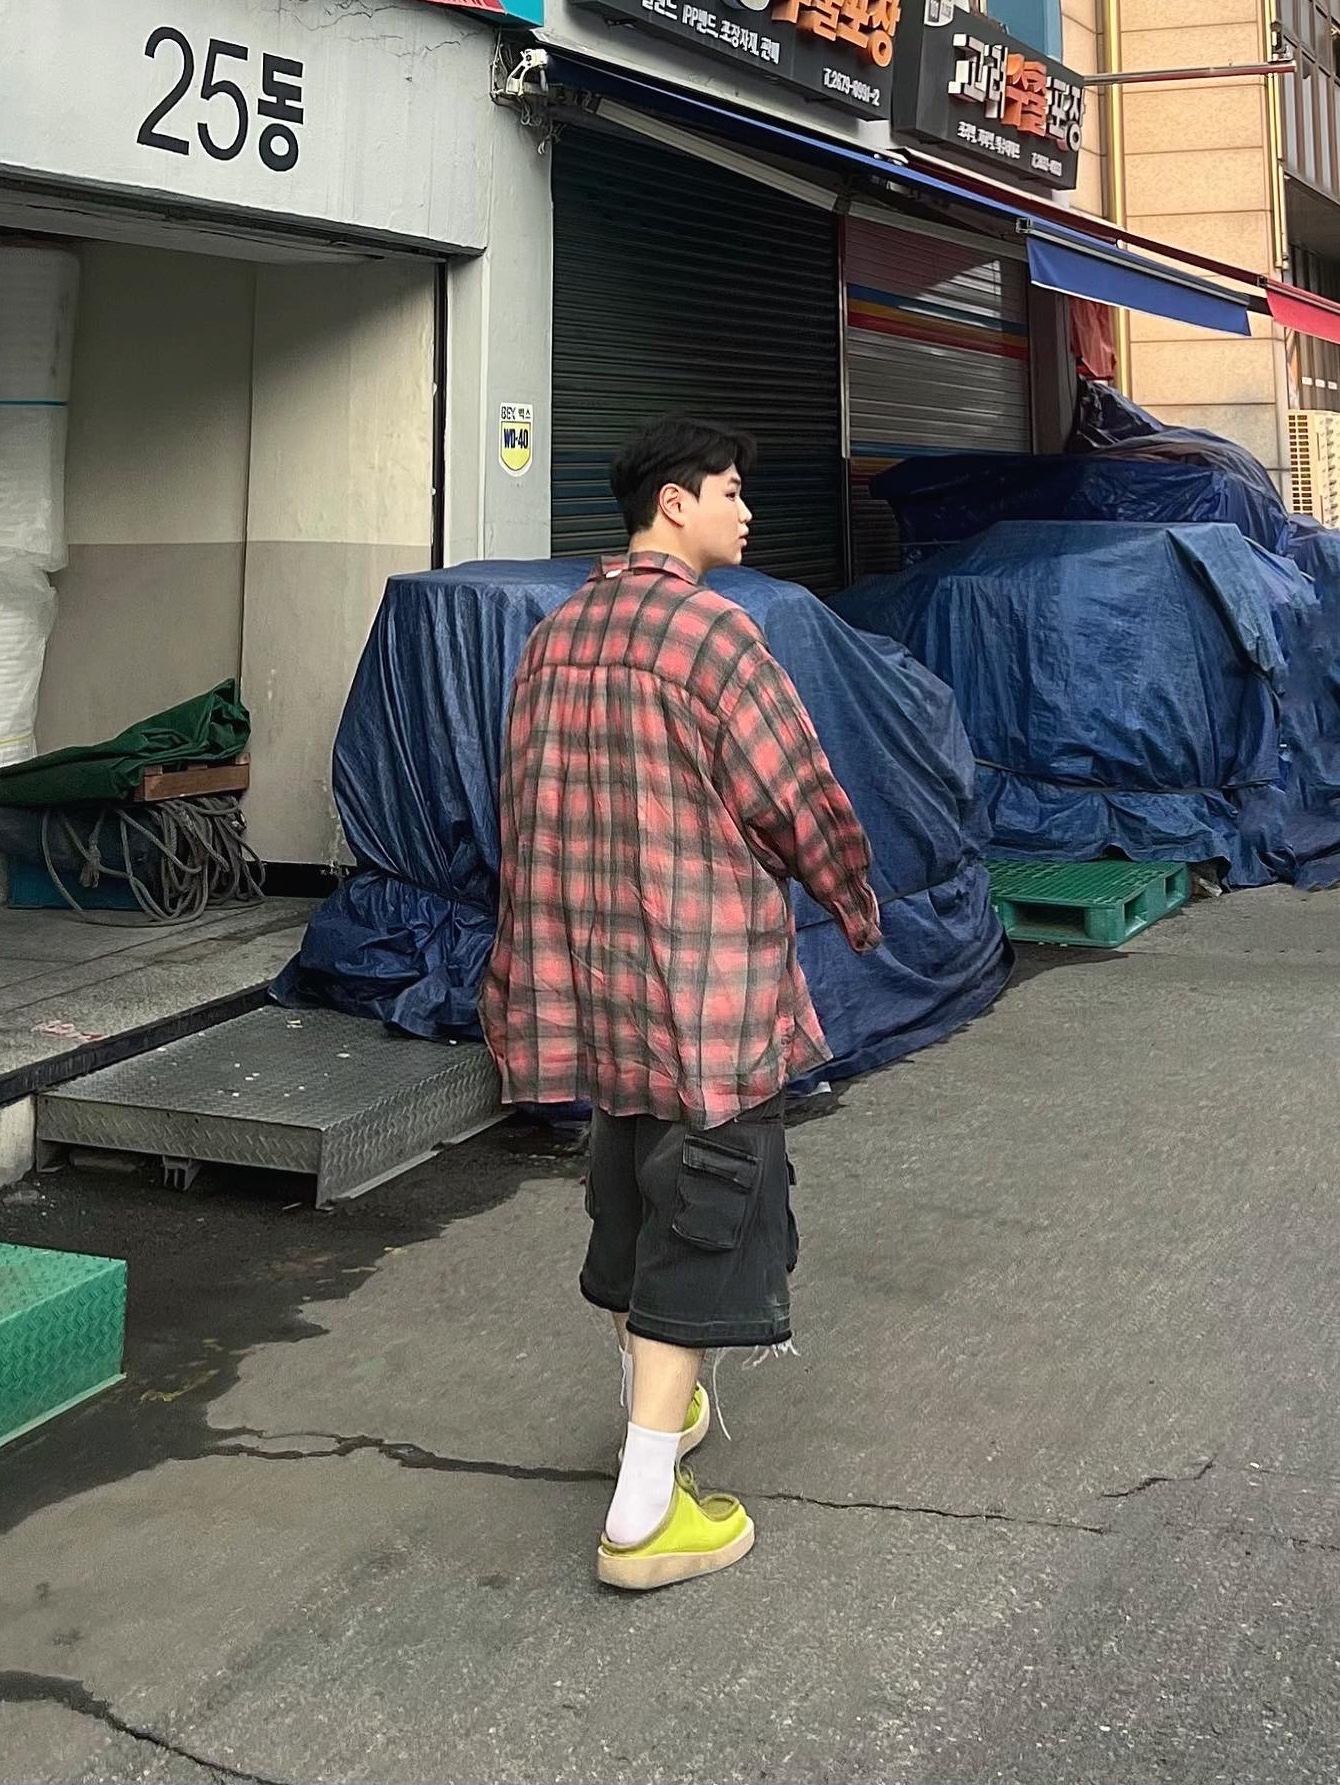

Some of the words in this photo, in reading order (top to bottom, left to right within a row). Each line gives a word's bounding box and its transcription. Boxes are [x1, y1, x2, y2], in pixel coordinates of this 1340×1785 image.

[682, 4, 719, 38] PP밴드
[719, 20, 760, 56] 포장자재
[760, 36, 781, 64] 판매
[137, 26, 304, 172] 25동
[948, 34, 1085, 151] 고려수출포장
[503, 428, 529, 449] WD-40
